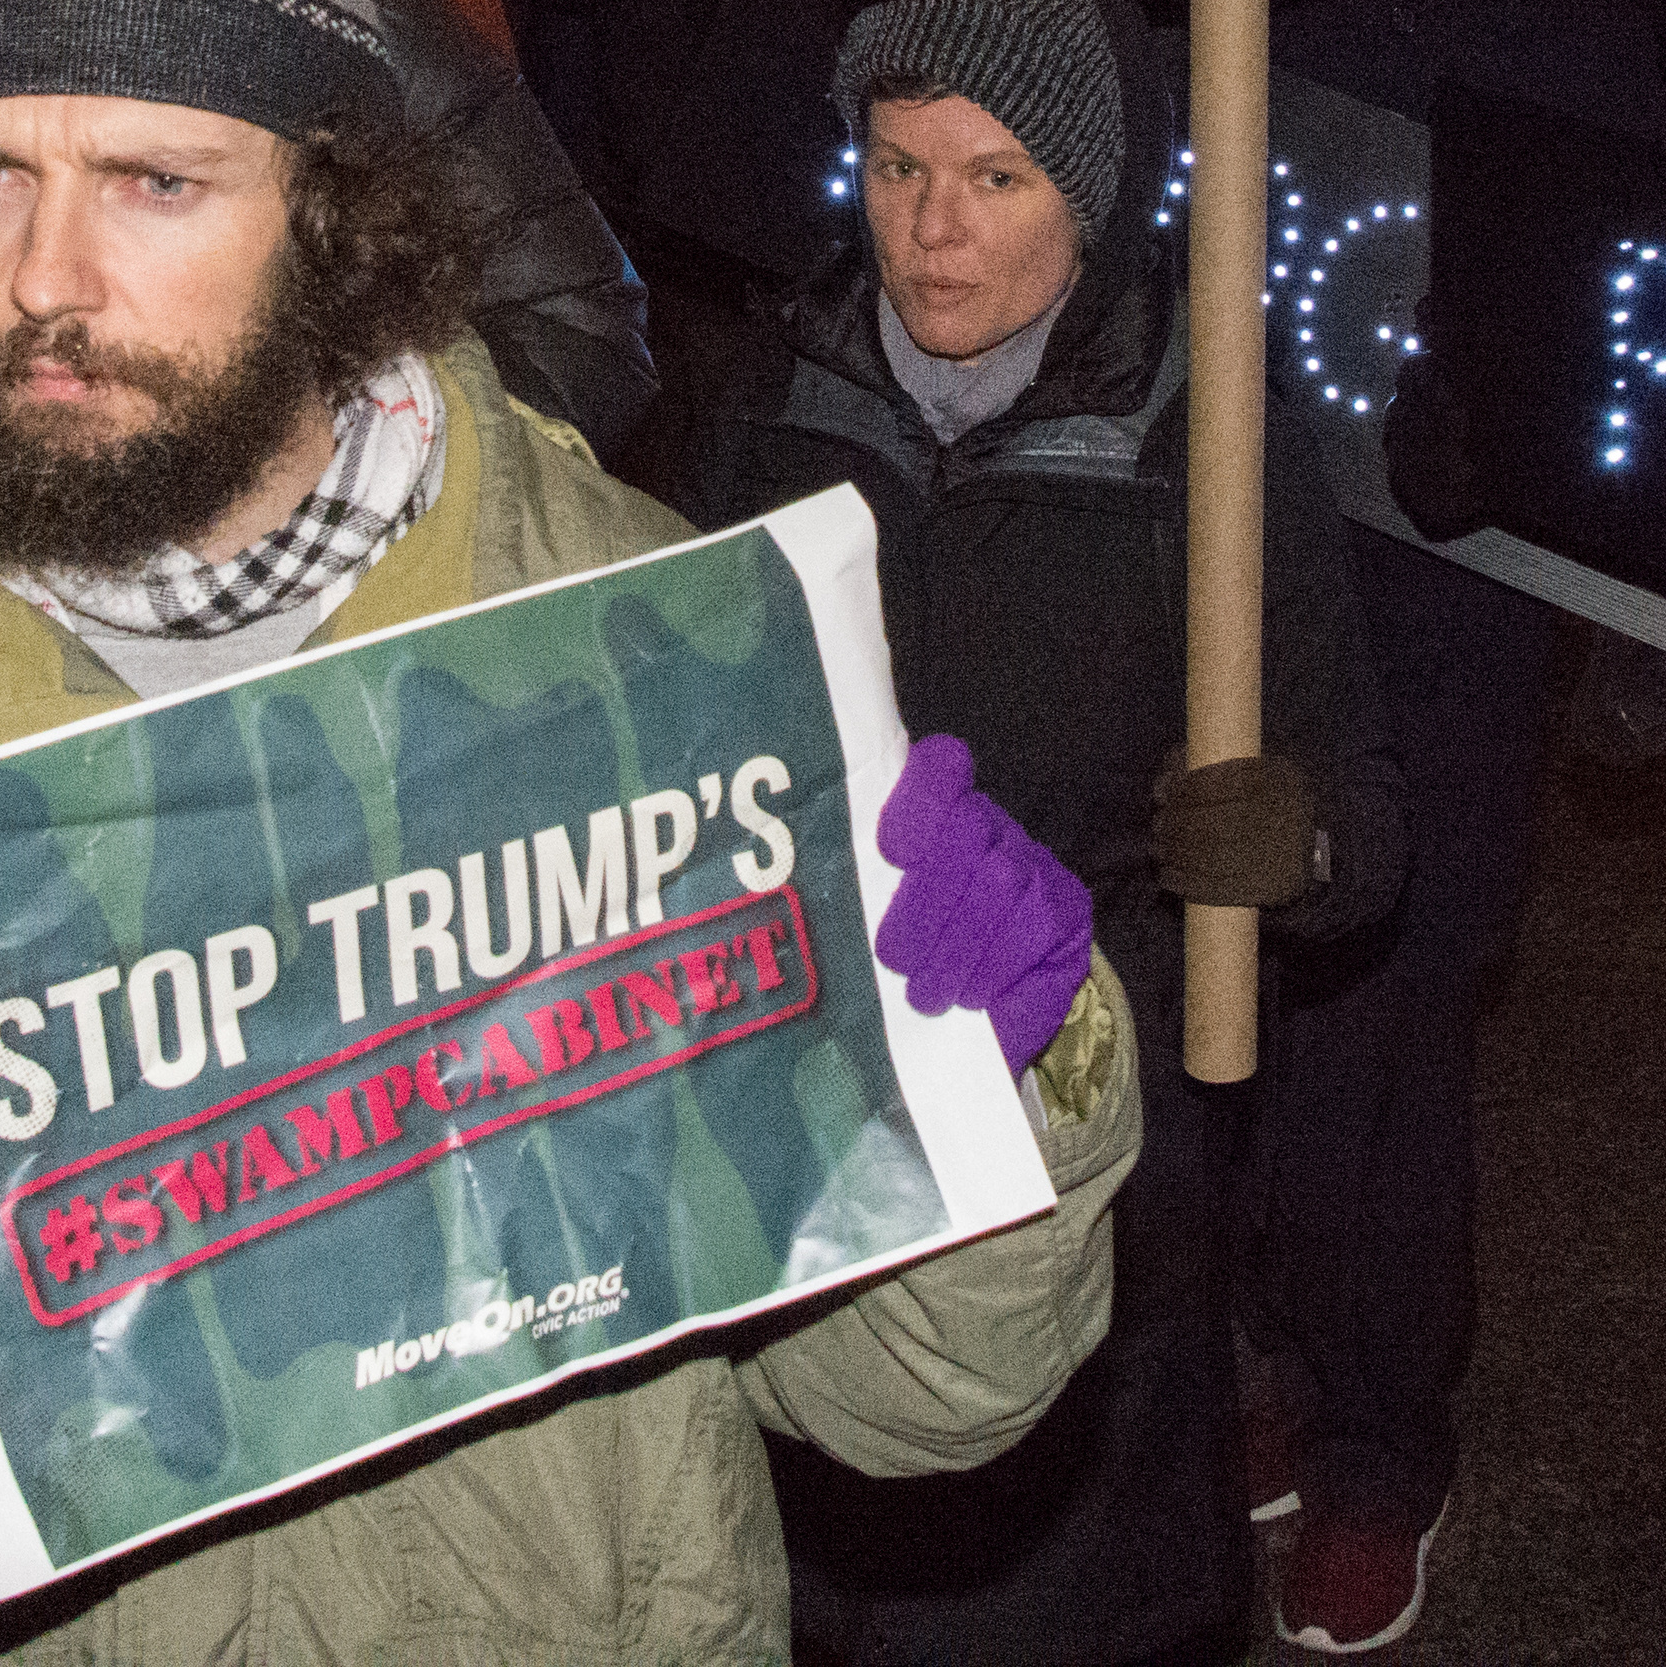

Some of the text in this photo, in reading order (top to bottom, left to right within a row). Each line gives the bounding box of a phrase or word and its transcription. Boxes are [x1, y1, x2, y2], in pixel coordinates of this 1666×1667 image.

[309, 755, 796, 1023] TRUMP'S
[40, 919, 787, 1284] #SWAMPCABINET
[532, 1298, 620, 1339] CIVIC ACTION
